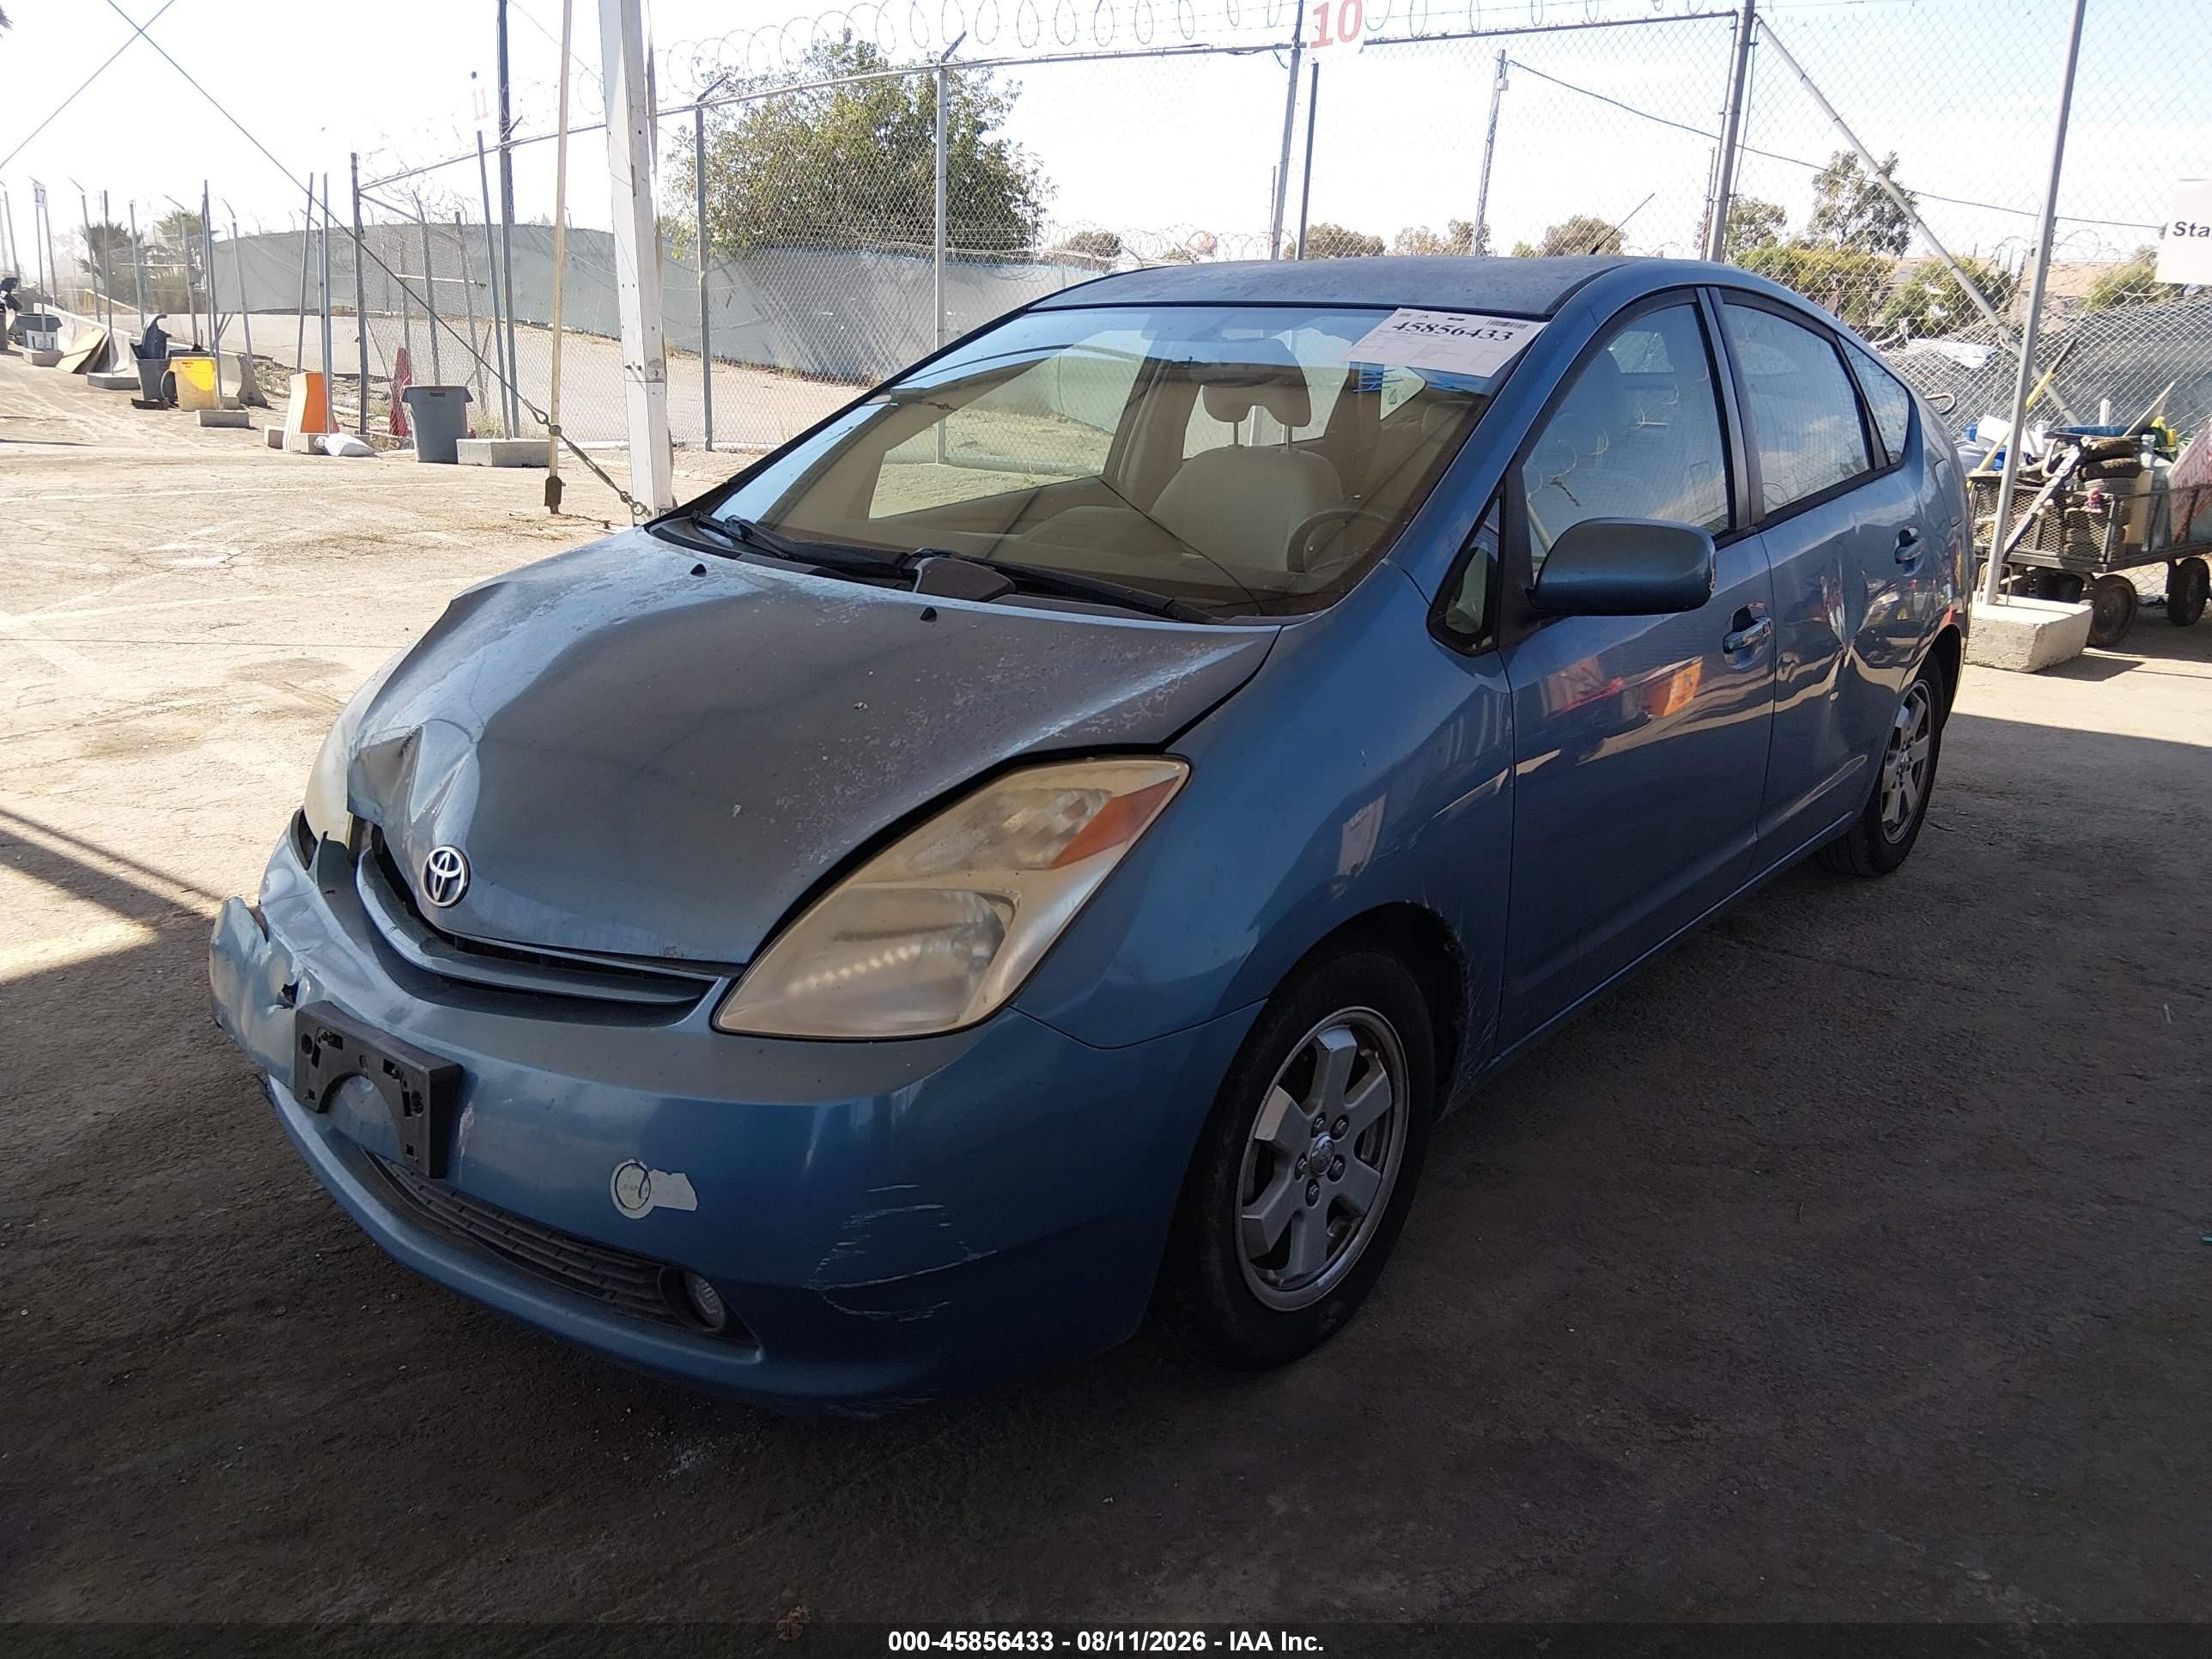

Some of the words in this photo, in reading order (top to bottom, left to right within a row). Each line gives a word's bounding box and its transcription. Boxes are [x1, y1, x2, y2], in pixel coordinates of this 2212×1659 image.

[1310, 0, 1363, 49] 10
[471, 86, 489, 122] 11
[34, 188, 46, 204] 17
[2172, 221, 2212, 238] Sta
[1392, 321, 1514, 342] 45856433
